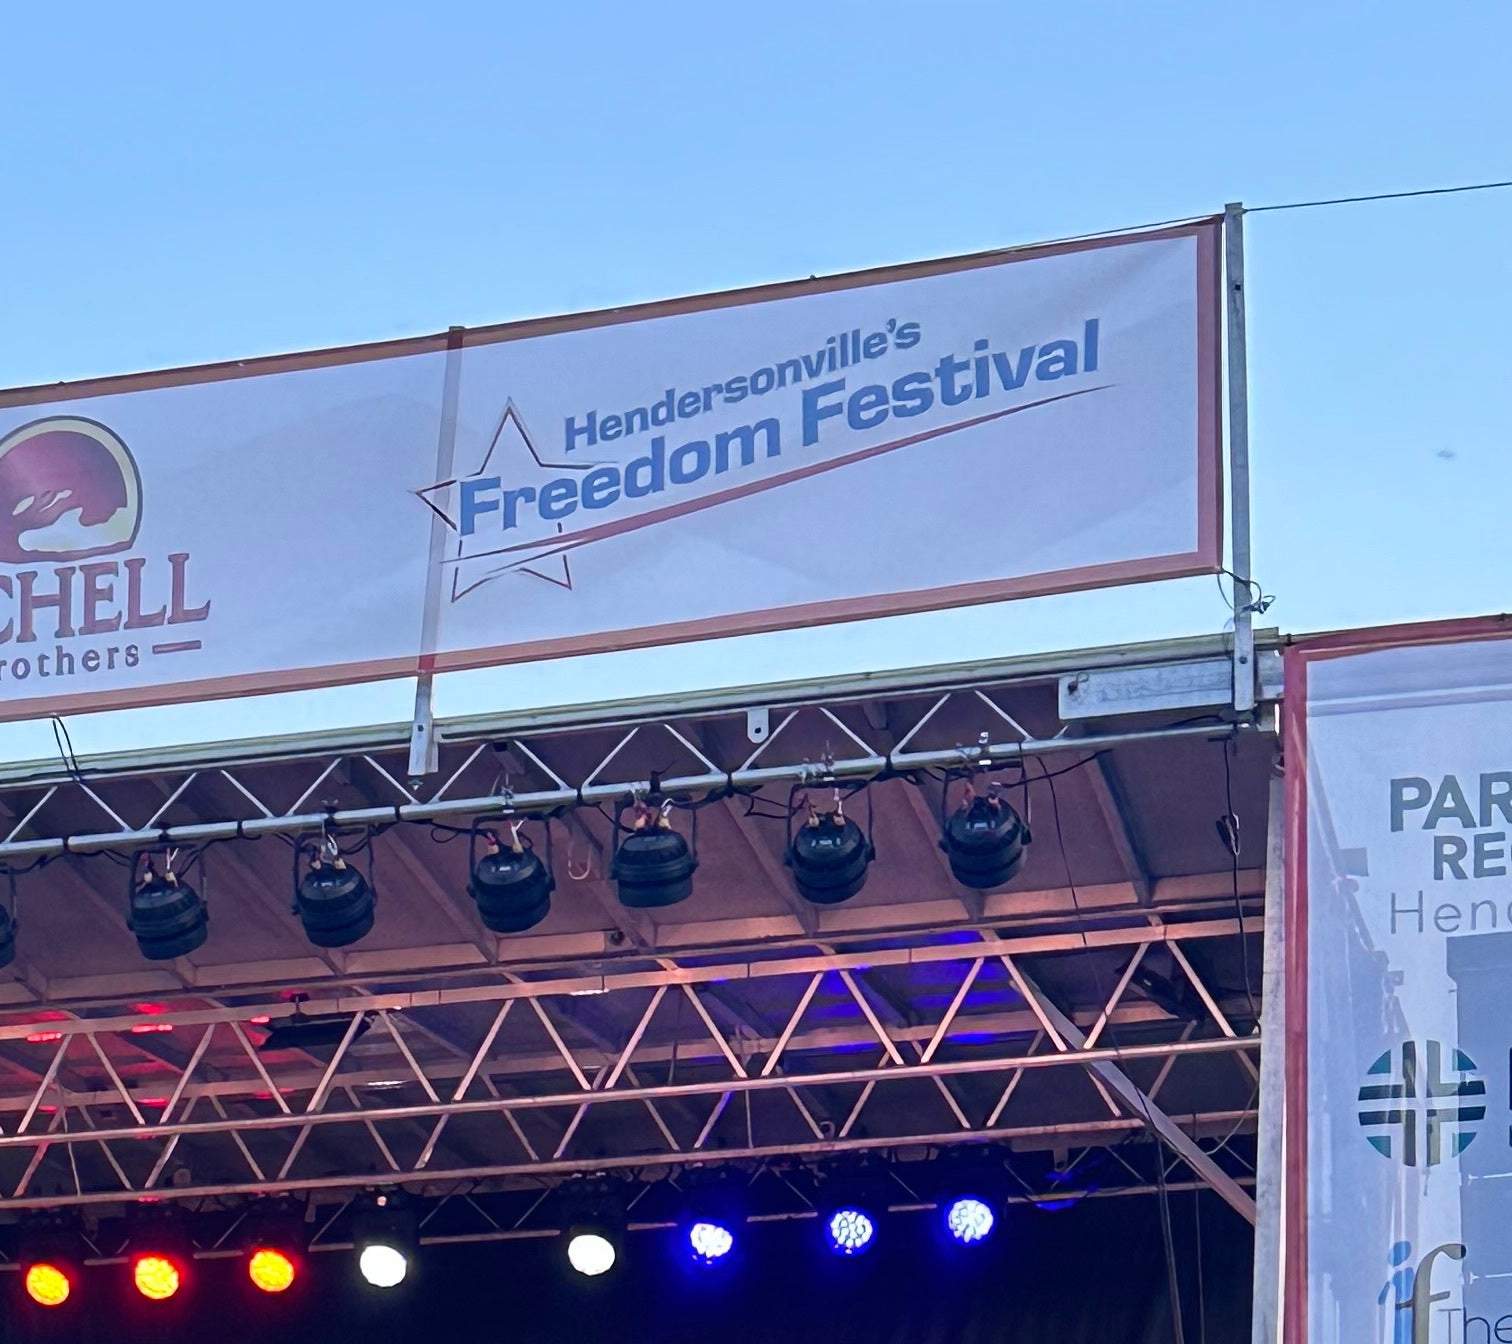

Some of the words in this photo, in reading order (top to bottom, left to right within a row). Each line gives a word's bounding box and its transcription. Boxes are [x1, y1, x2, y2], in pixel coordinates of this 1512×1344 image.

[459, 416, 781, 535] Freedom
[801, 318, 1101, 447] Festival
[564, 318, 921, 453] Hendersonville's
[1434, 832, 1512, 880] RE
[1391, 890, 1512, 934] Hen
